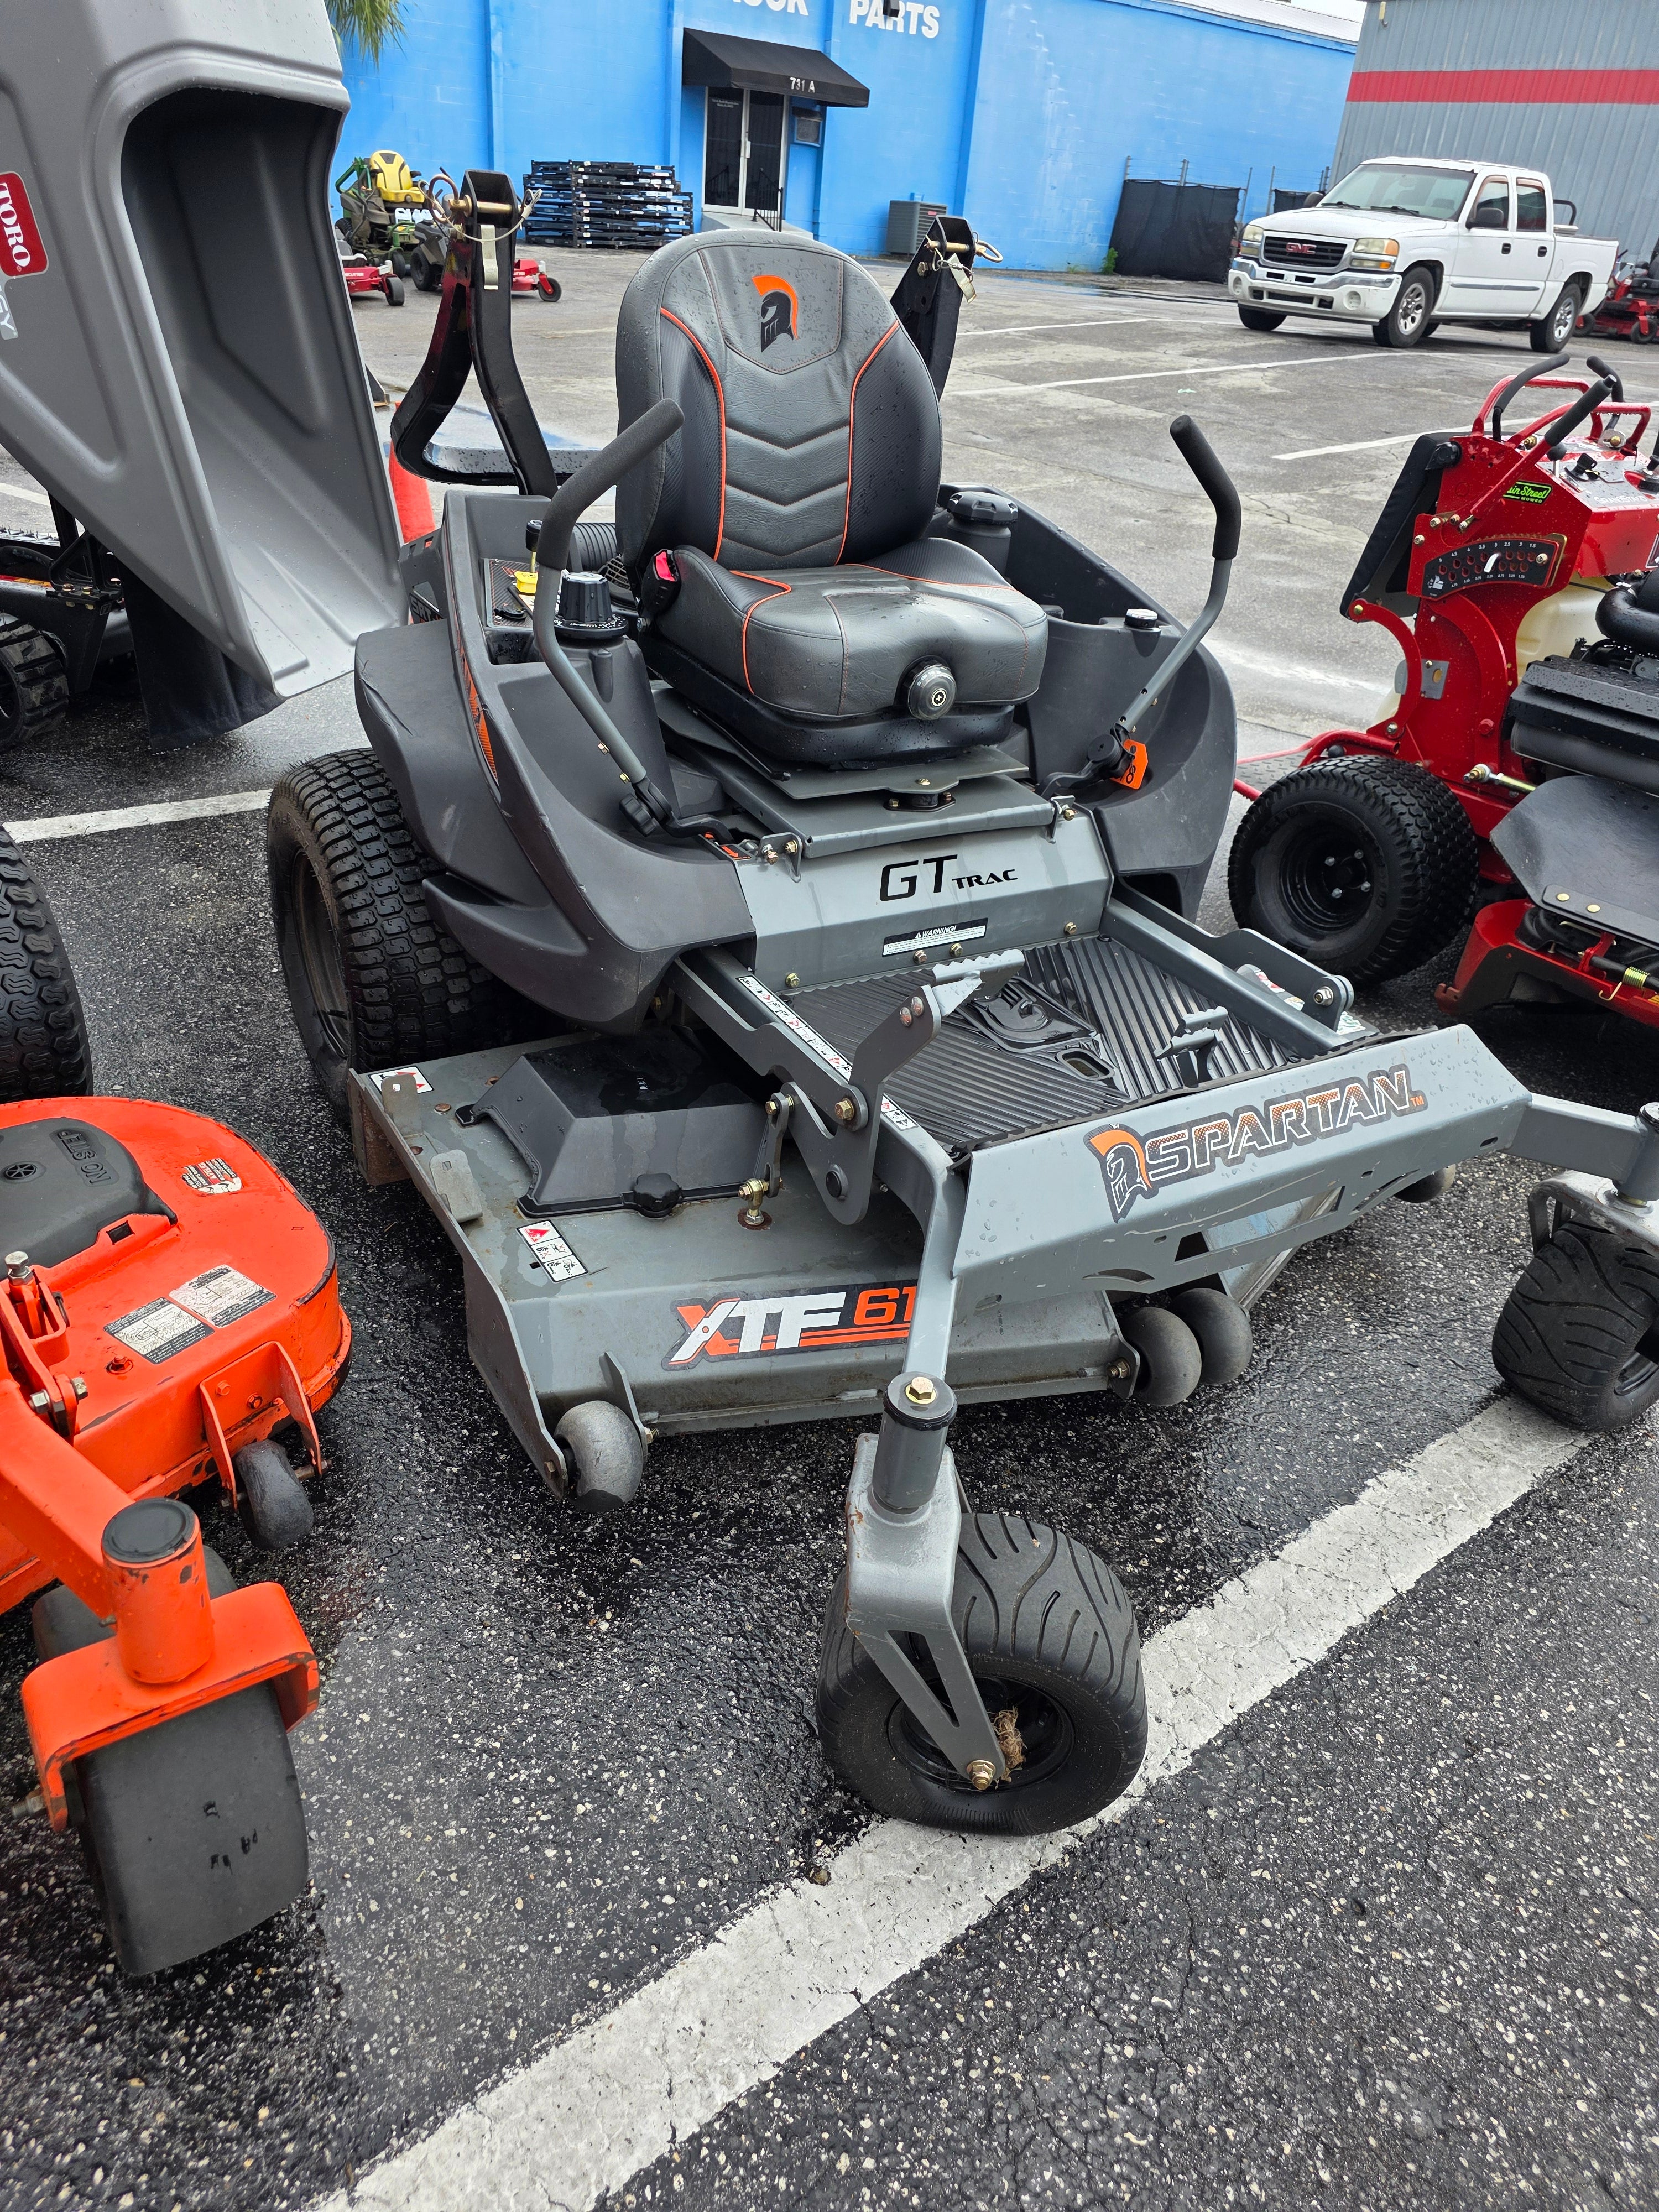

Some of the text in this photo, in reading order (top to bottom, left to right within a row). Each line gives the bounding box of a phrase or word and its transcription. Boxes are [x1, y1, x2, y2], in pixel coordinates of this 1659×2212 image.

[790, 77, 815, 93] 731 A
[0, 182, 30, 267] TORO
[1286, 242, 1317, 254] GMC
[1520, 486, 1547, 499] Street
[879, 854, 1018, 901] GT TRAC
[922, 925, 957, 937] WARNING!
[1146, 1070, 1410, 1181] SPARTAN
[57, 1131, 111, 1184] NO STEP
[197, 1162, 214, 1175] PELIG
[667, 1286, 917, 1365] XTF 61
